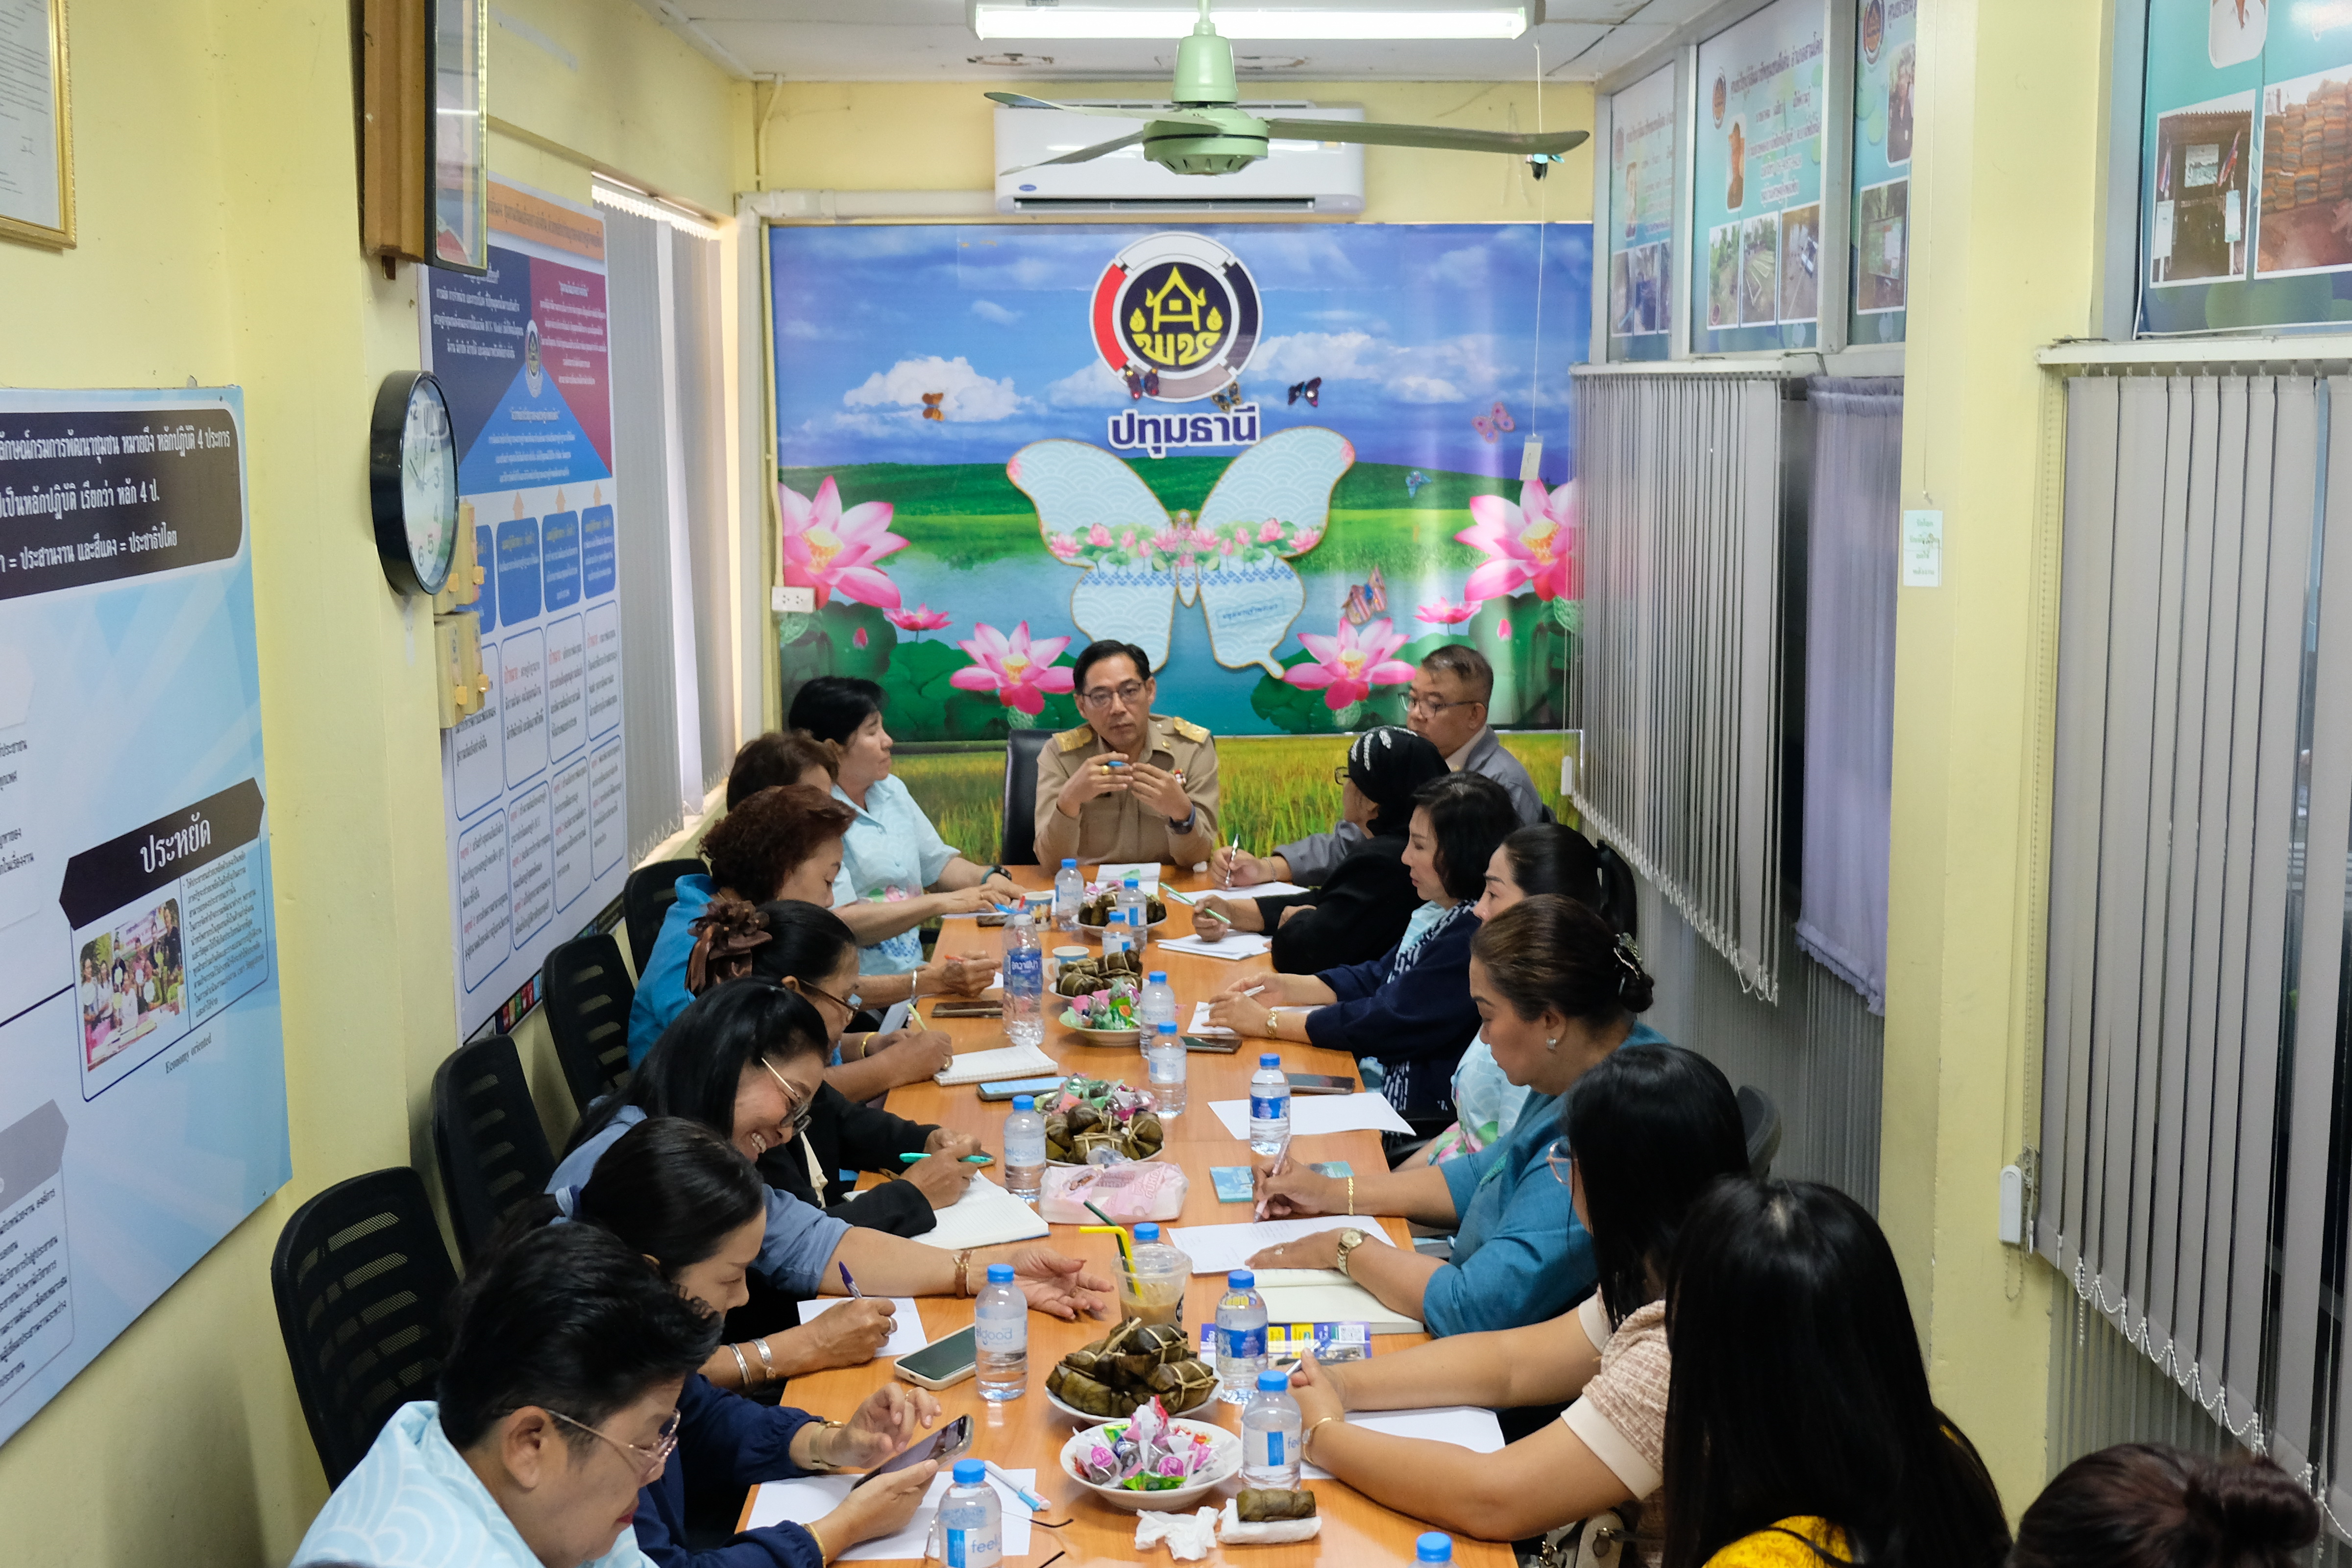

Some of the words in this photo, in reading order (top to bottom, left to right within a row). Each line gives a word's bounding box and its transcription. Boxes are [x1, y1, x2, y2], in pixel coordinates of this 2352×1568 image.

[122, 426, 155, 454] หมายถึง
[157, 425, 196, 457] หลักปฏิบัติ
[197, 429, 204, 449] 4
[205, 426, 230, 449] ประการ
[1111, 405, 1257, 455] ปทุมธานี
[0, 482, 77, 520] เป็นหลักปฏิบัติ
[80, 479, 115, 510] เรียกว่า
[117, 477, 138, 505] หลัก
[140, 481, 147, 503] 4
[149, 478, 160, 502] ป.
[20, 545, 75, 570] ประสานงาน
[77, 532, 118, 562] และสีแดง
[128, 521, 177, 553] ประชาธิปไตย
[417, 545, 424, 567] 6
[140, 811, 211, 874] ประหยัด
[165, 1050, 190, 1074] Economy
[971, 1533, 1001, 1554] feel
